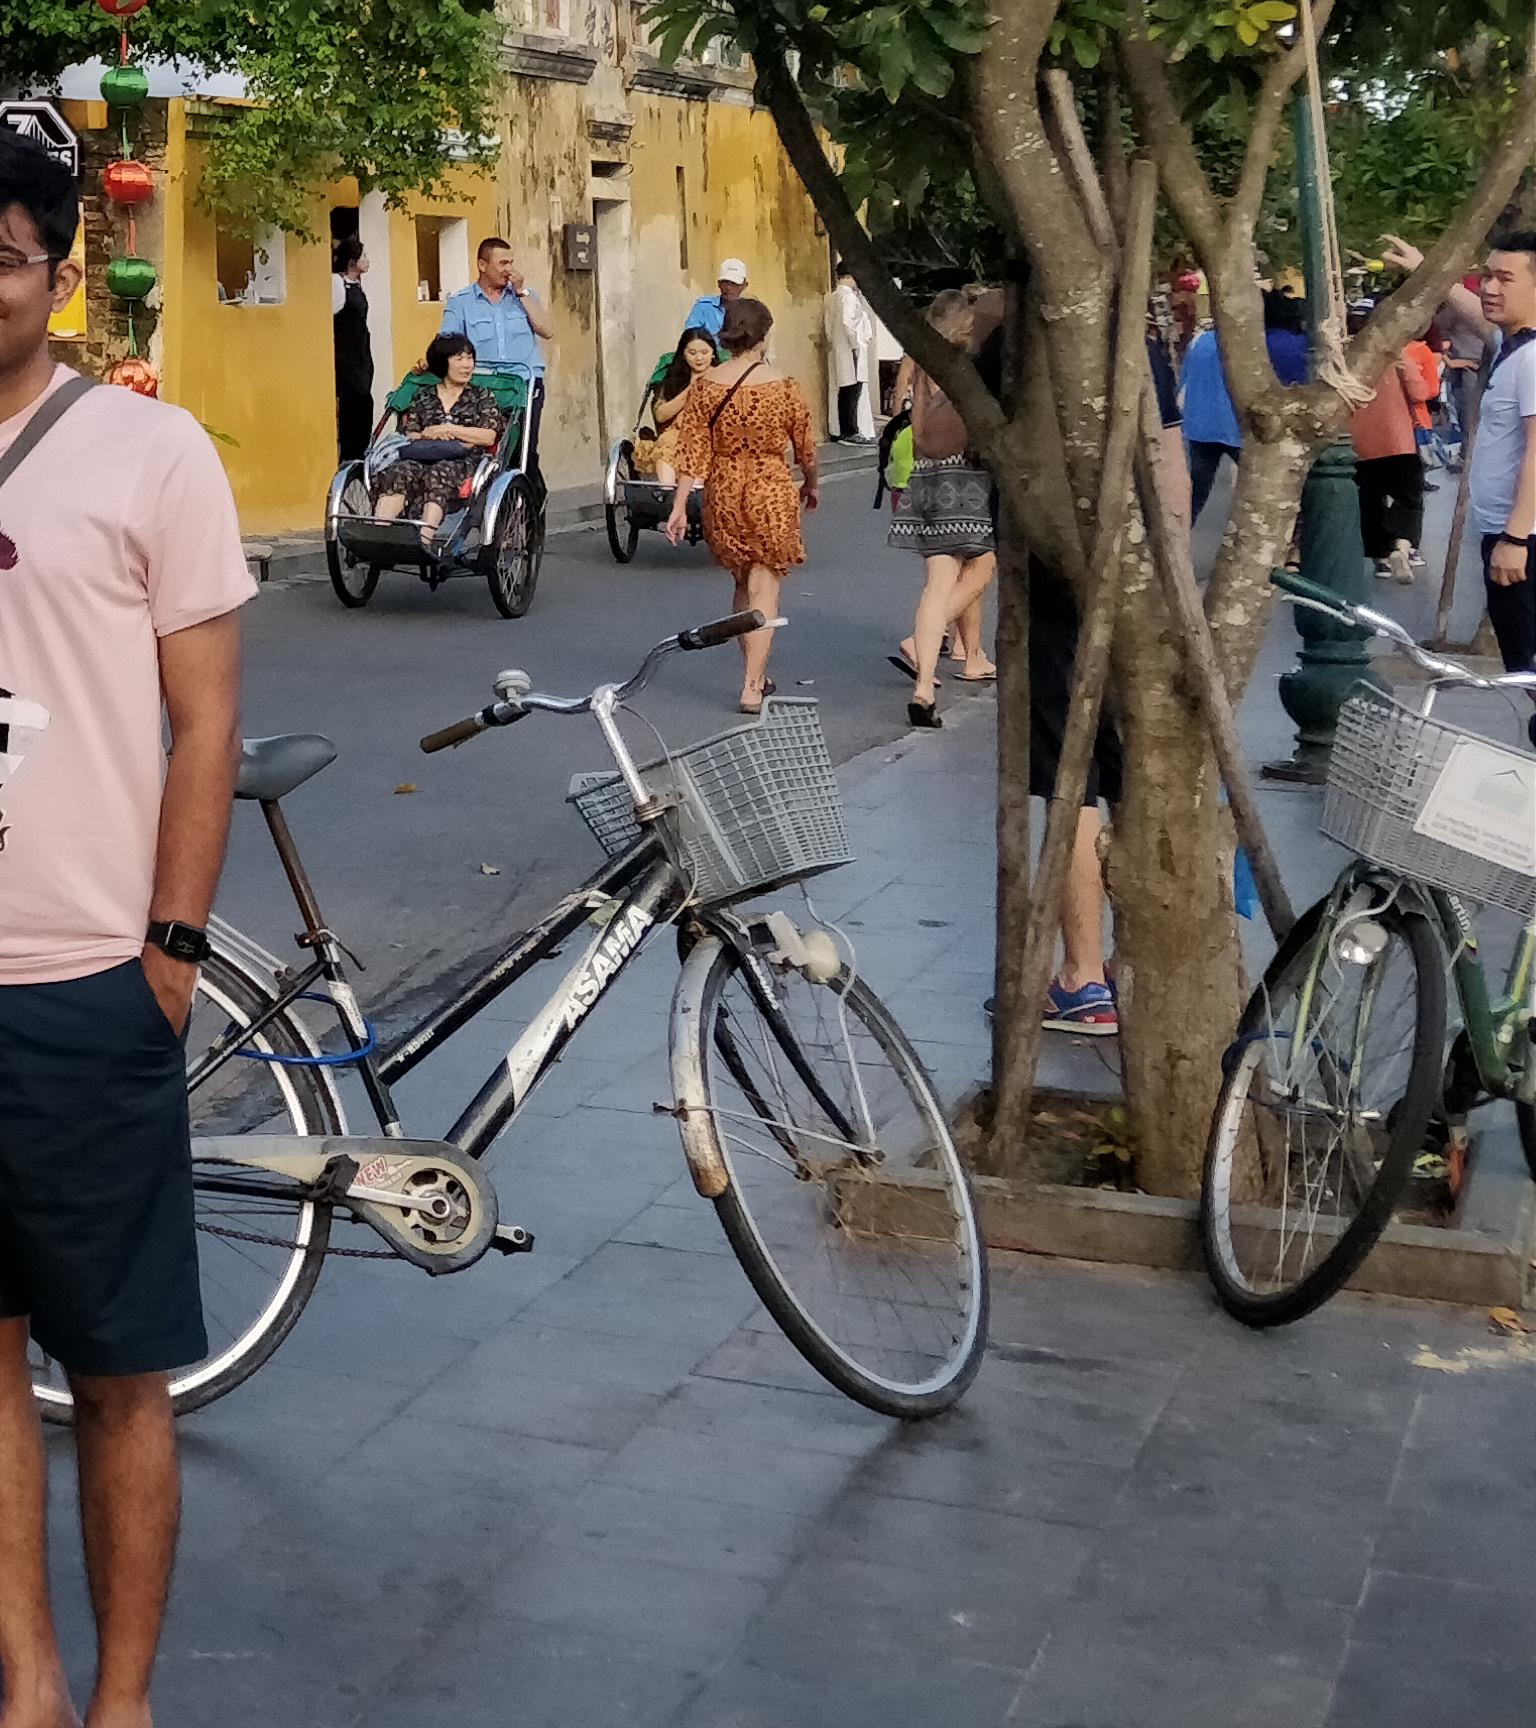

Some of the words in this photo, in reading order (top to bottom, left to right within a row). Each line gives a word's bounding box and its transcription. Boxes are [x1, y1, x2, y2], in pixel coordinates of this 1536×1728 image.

[1447, 893, 1472, 932] artin
[561, 904, 655, 1033] ASAMA
[354, 1156, 387, 1186] NEW
